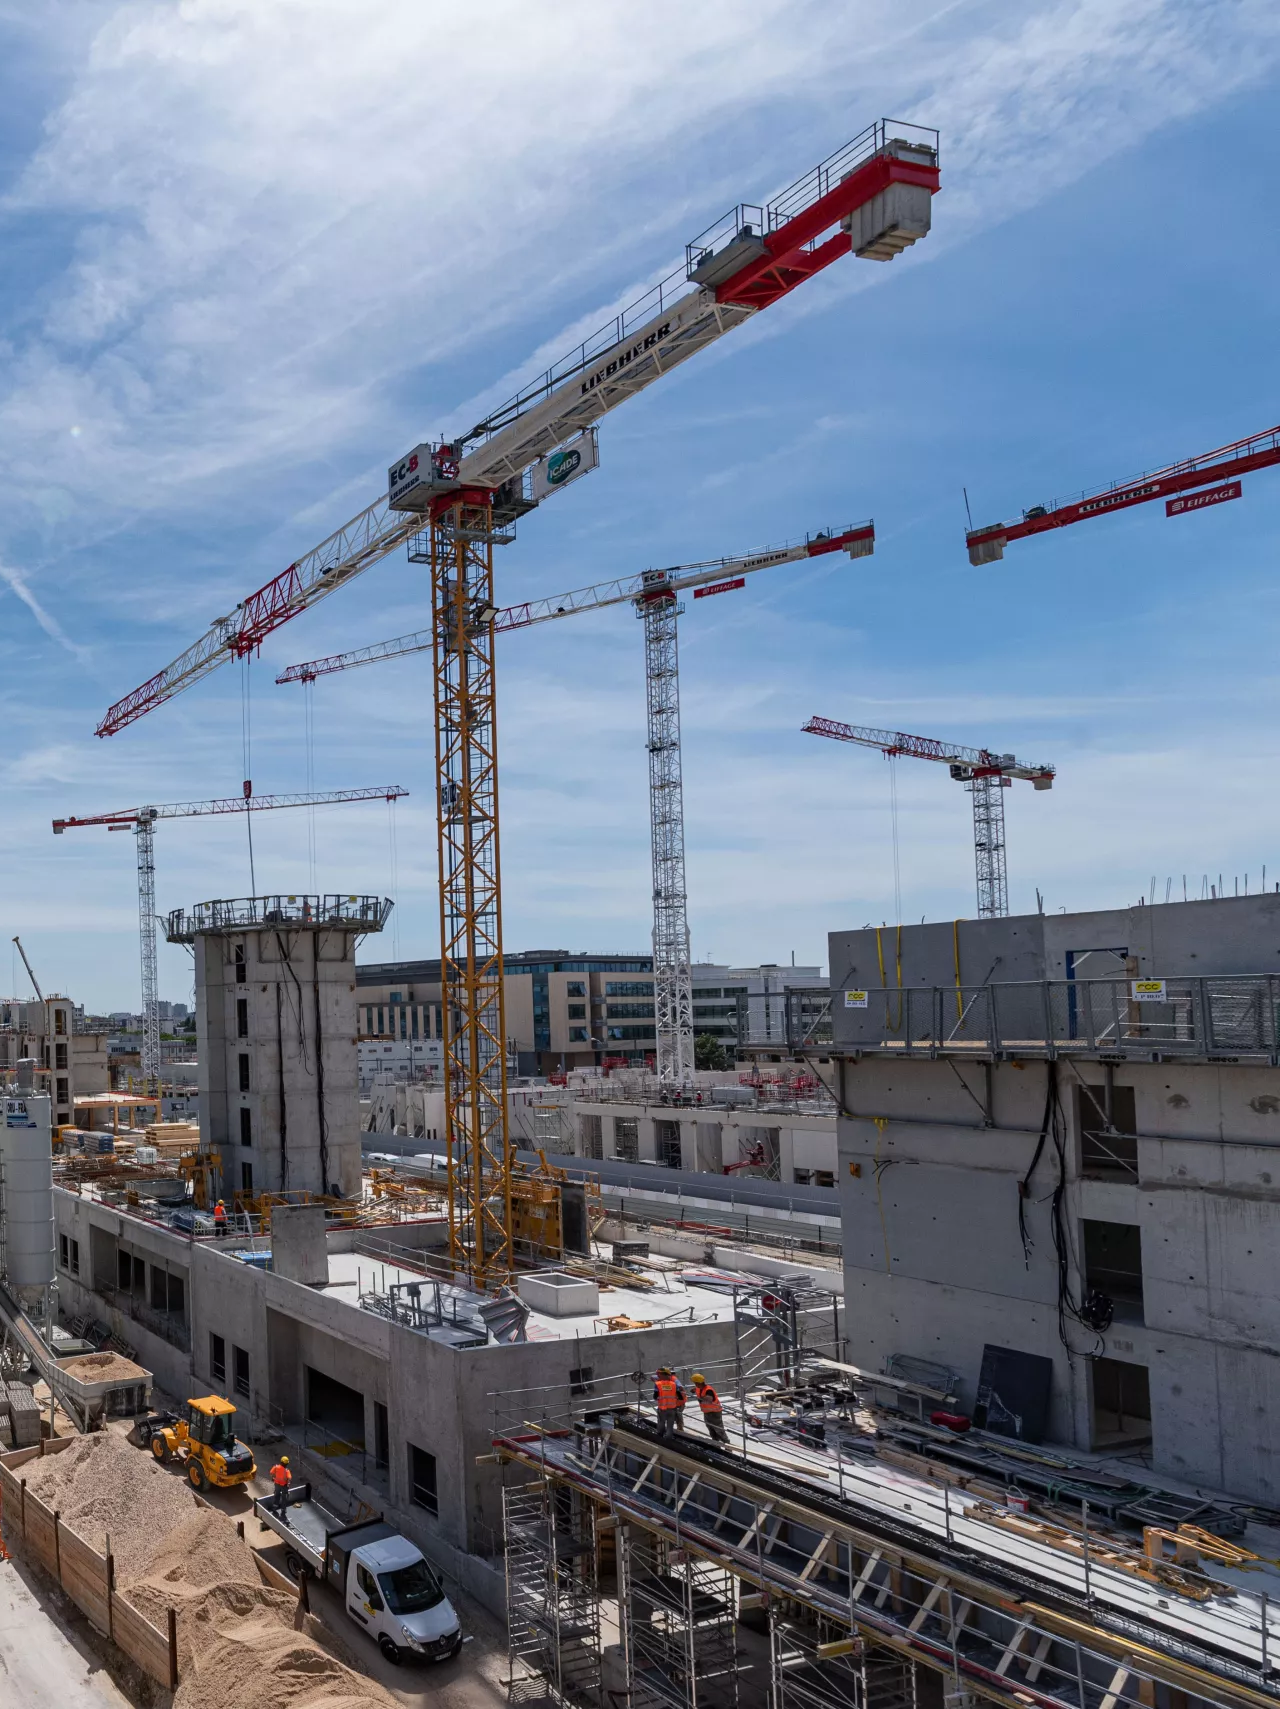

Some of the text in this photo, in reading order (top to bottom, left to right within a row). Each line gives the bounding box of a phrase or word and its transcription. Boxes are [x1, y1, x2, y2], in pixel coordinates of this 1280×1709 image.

[581, 322, 670, 395] LIEBHERR
[390, 454, 419, 488] EC-B
[549, 453, 579, 479] ICADE
[1187, 488, 1235, 508] EIFFAGE
[1206, 1055, 1239, 1063] sateco
